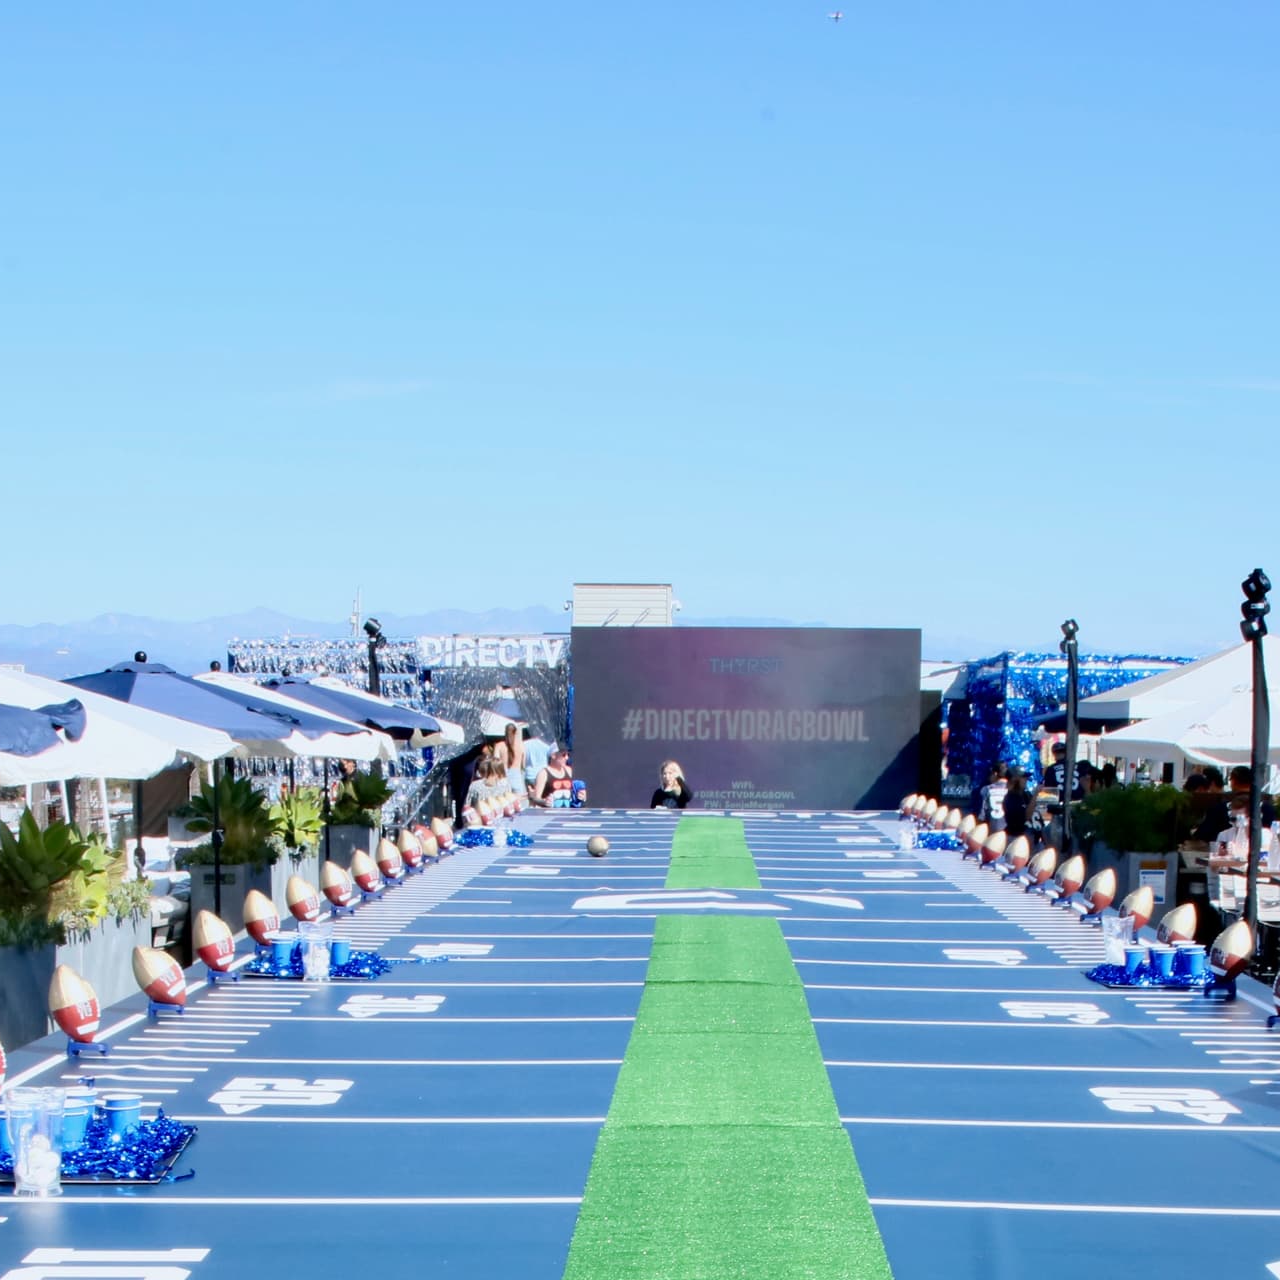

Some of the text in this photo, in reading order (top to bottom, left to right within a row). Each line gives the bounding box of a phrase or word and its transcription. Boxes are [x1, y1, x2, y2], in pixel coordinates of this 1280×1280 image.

[421, 636, 563, 668] DIRECTV
[622, 708, 869, 742] #DIRECTVDRAGBOWL
[207, 1077, 354, 1107] 20
[1089, 1087, 1241, 1117] 20
